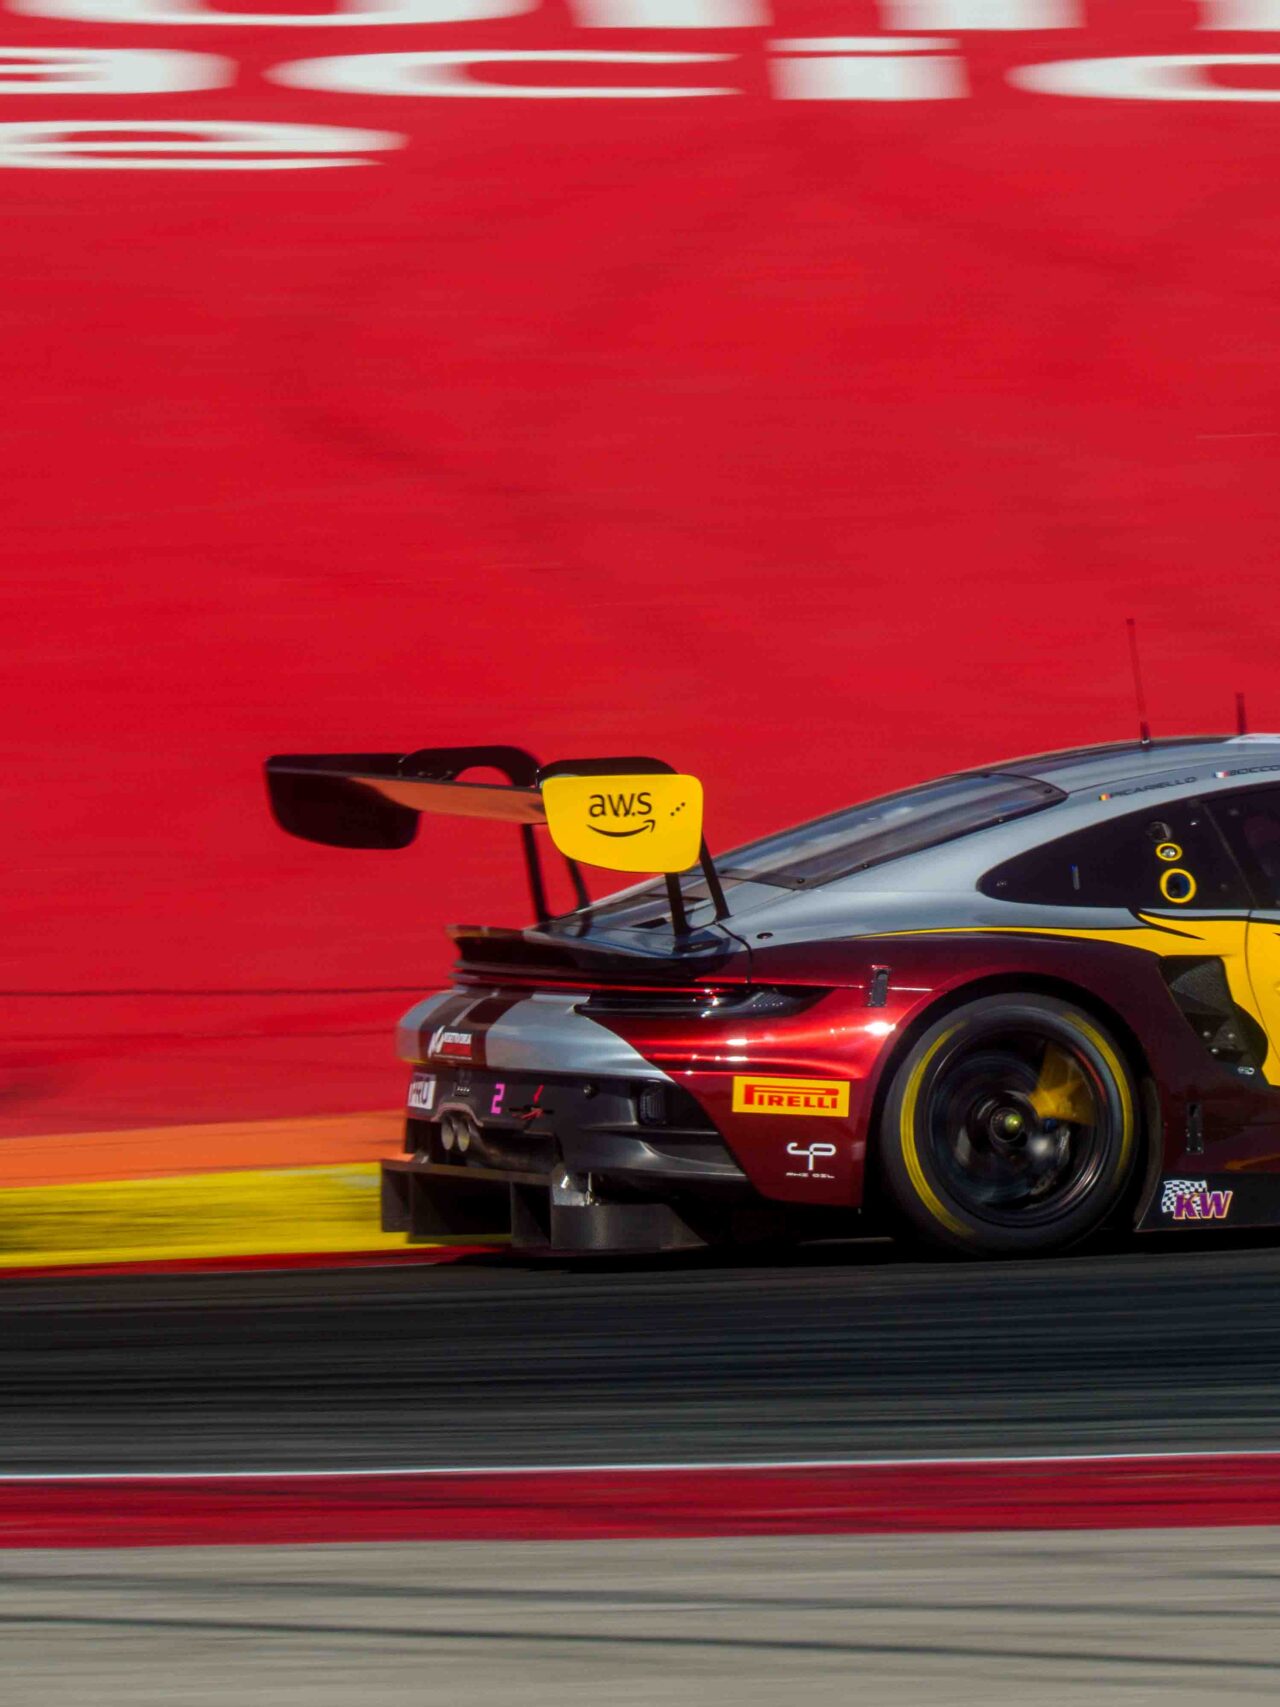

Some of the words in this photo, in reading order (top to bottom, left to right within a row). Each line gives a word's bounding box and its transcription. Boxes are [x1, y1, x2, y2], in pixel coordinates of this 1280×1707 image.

[588, 791, 653, 818] aws
[490, 1082, 505, 1114] 2
[743, 1084, 839, 1109] PIRELLI
[1172, 1190, 1233, 1220] KW
